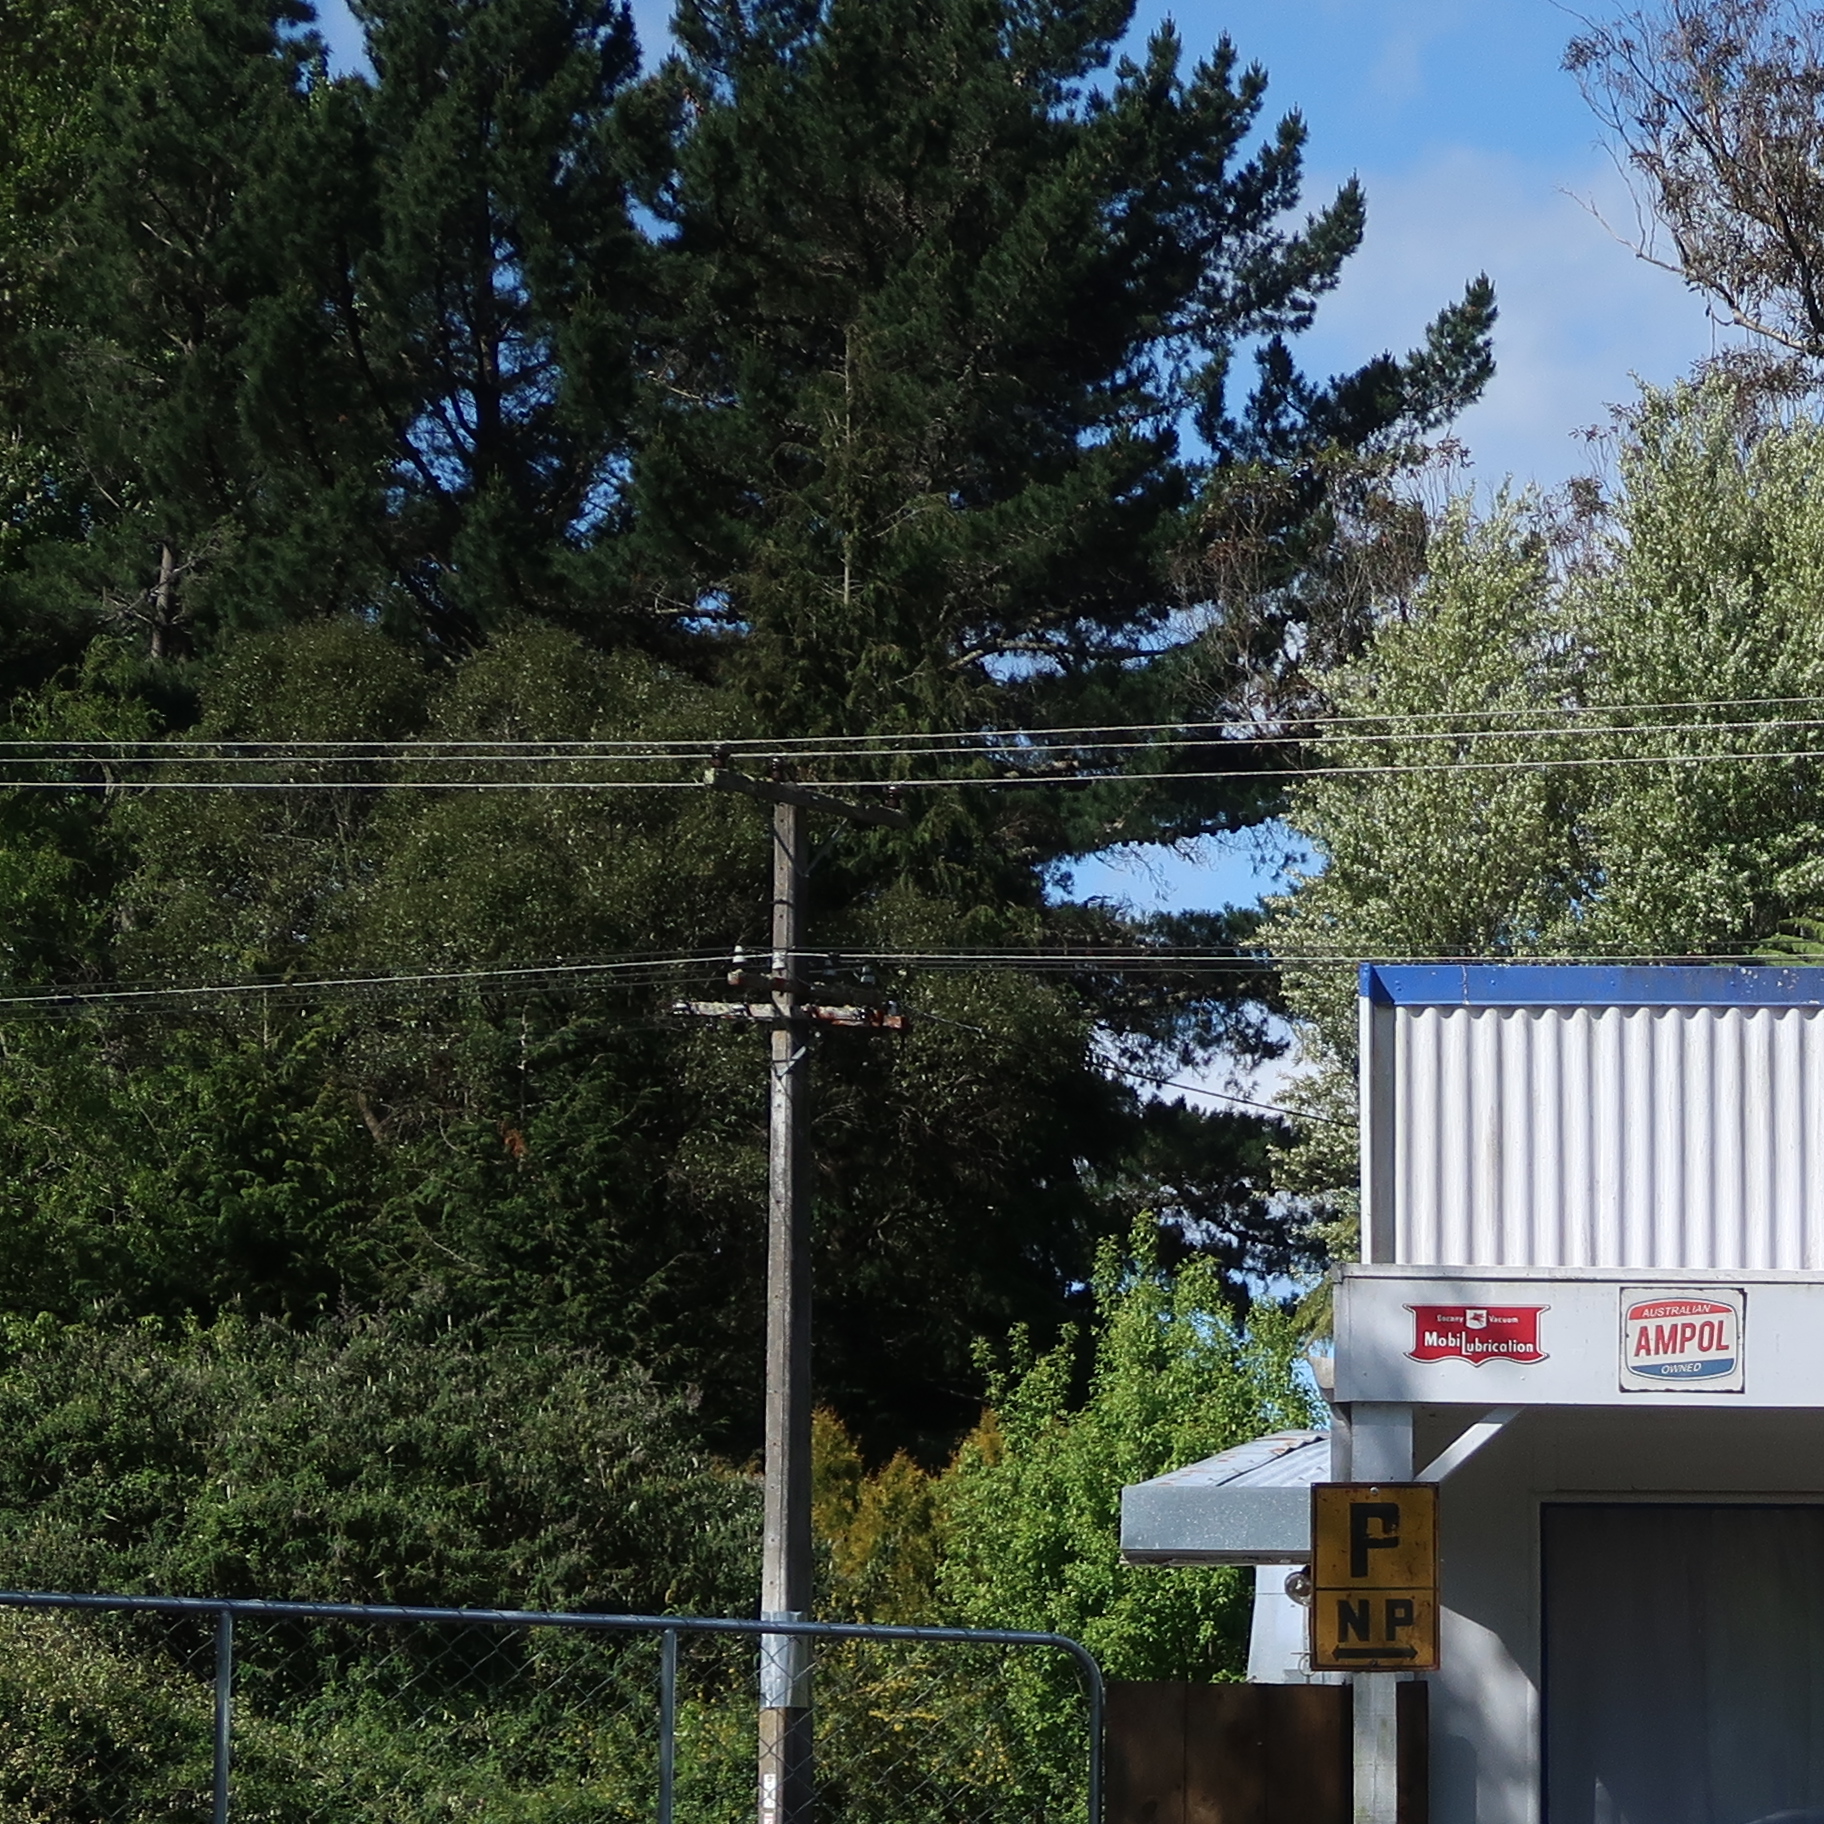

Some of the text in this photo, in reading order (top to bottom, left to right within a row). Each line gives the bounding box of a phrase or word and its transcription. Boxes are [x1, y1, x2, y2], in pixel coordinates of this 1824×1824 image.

[1641, 1304, 1711, 1318] AUSTRALIAN
[1488, 1315, 1520, 1324] Vacuum
[1633, 1320, 1730, 1357] AMPOL
[1660, 1362, 1702, 1374] OWNED
[1350, 1502, 1399, 1578] P
